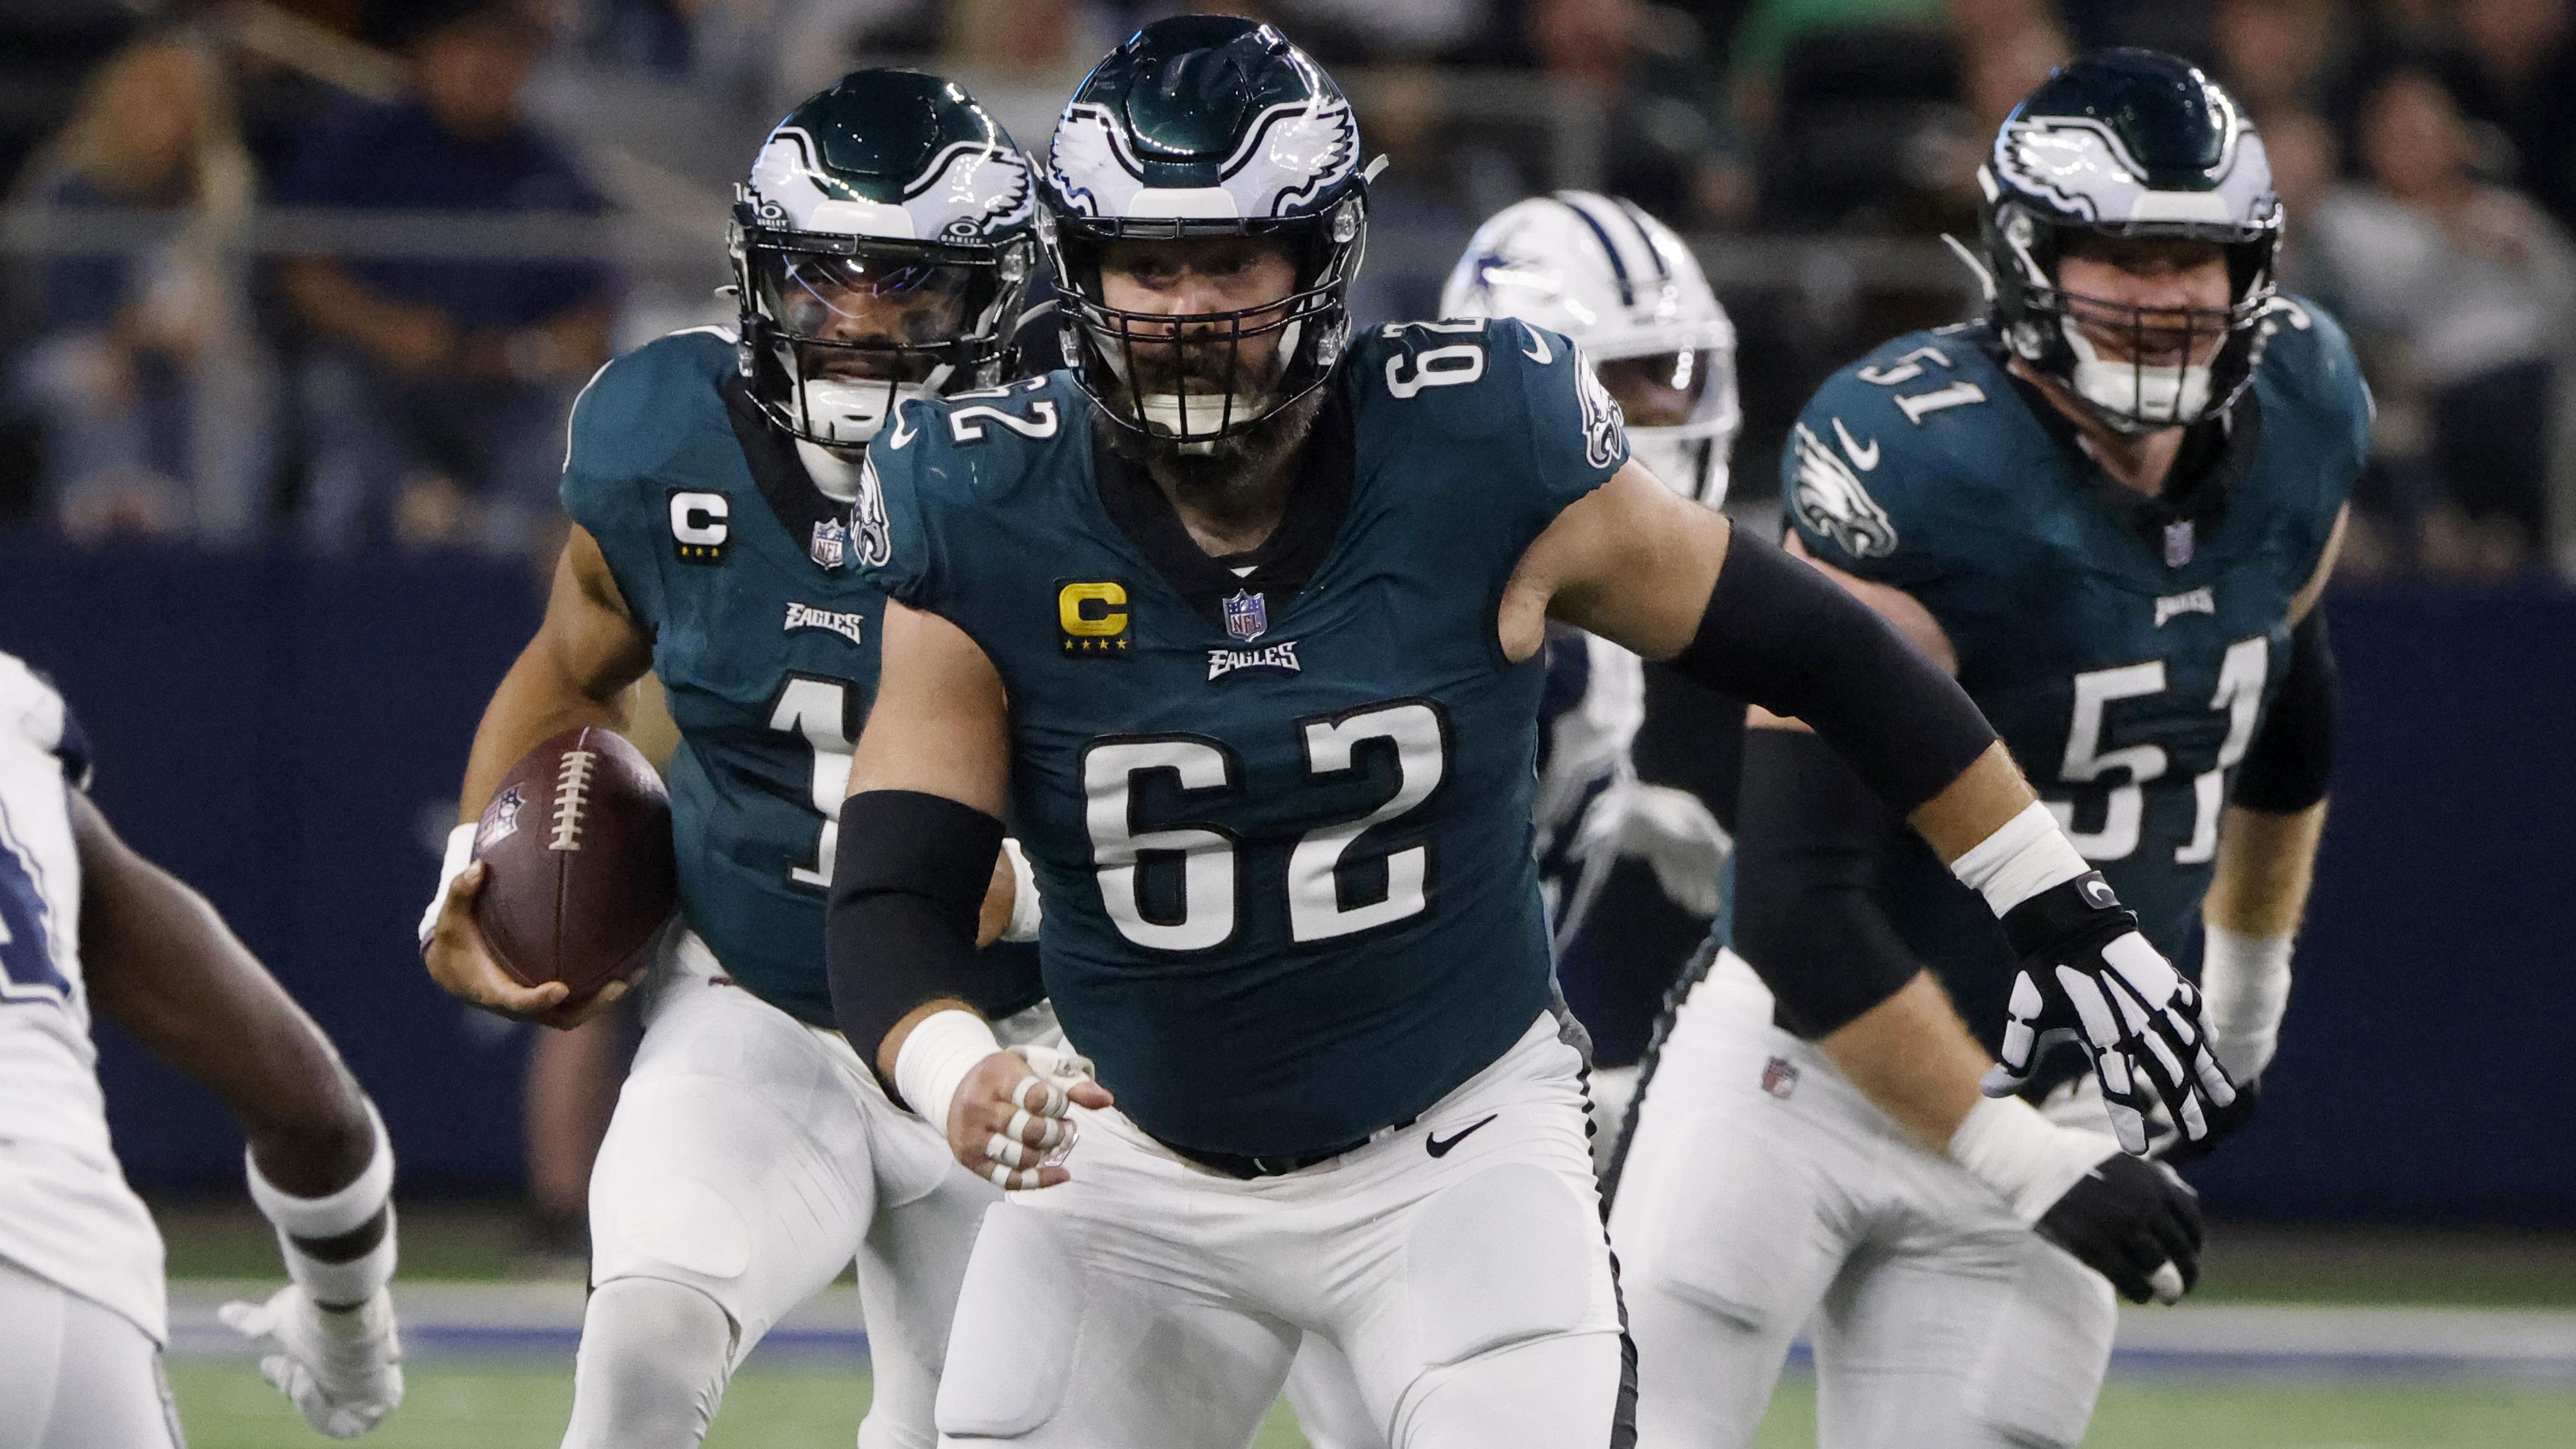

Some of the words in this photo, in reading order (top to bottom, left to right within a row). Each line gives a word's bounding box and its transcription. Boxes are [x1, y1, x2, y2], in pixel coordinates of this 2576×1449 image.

[1857, 347, 1987, 424] 51
[670, 492, 728, 545] C
[818, 540, 839, 560] NFL
[784, 602, 864, 645] EAGLES
[1059, 582, 1128, 636] C
[1232, 614, 1261, 633] NFL
[1208, 641, 1301, 681] EAGLES
[2042, 636, 2268, 864] 51
[769, 678, 854, 888] 1
[1085, 704, 1443, 950] 62
